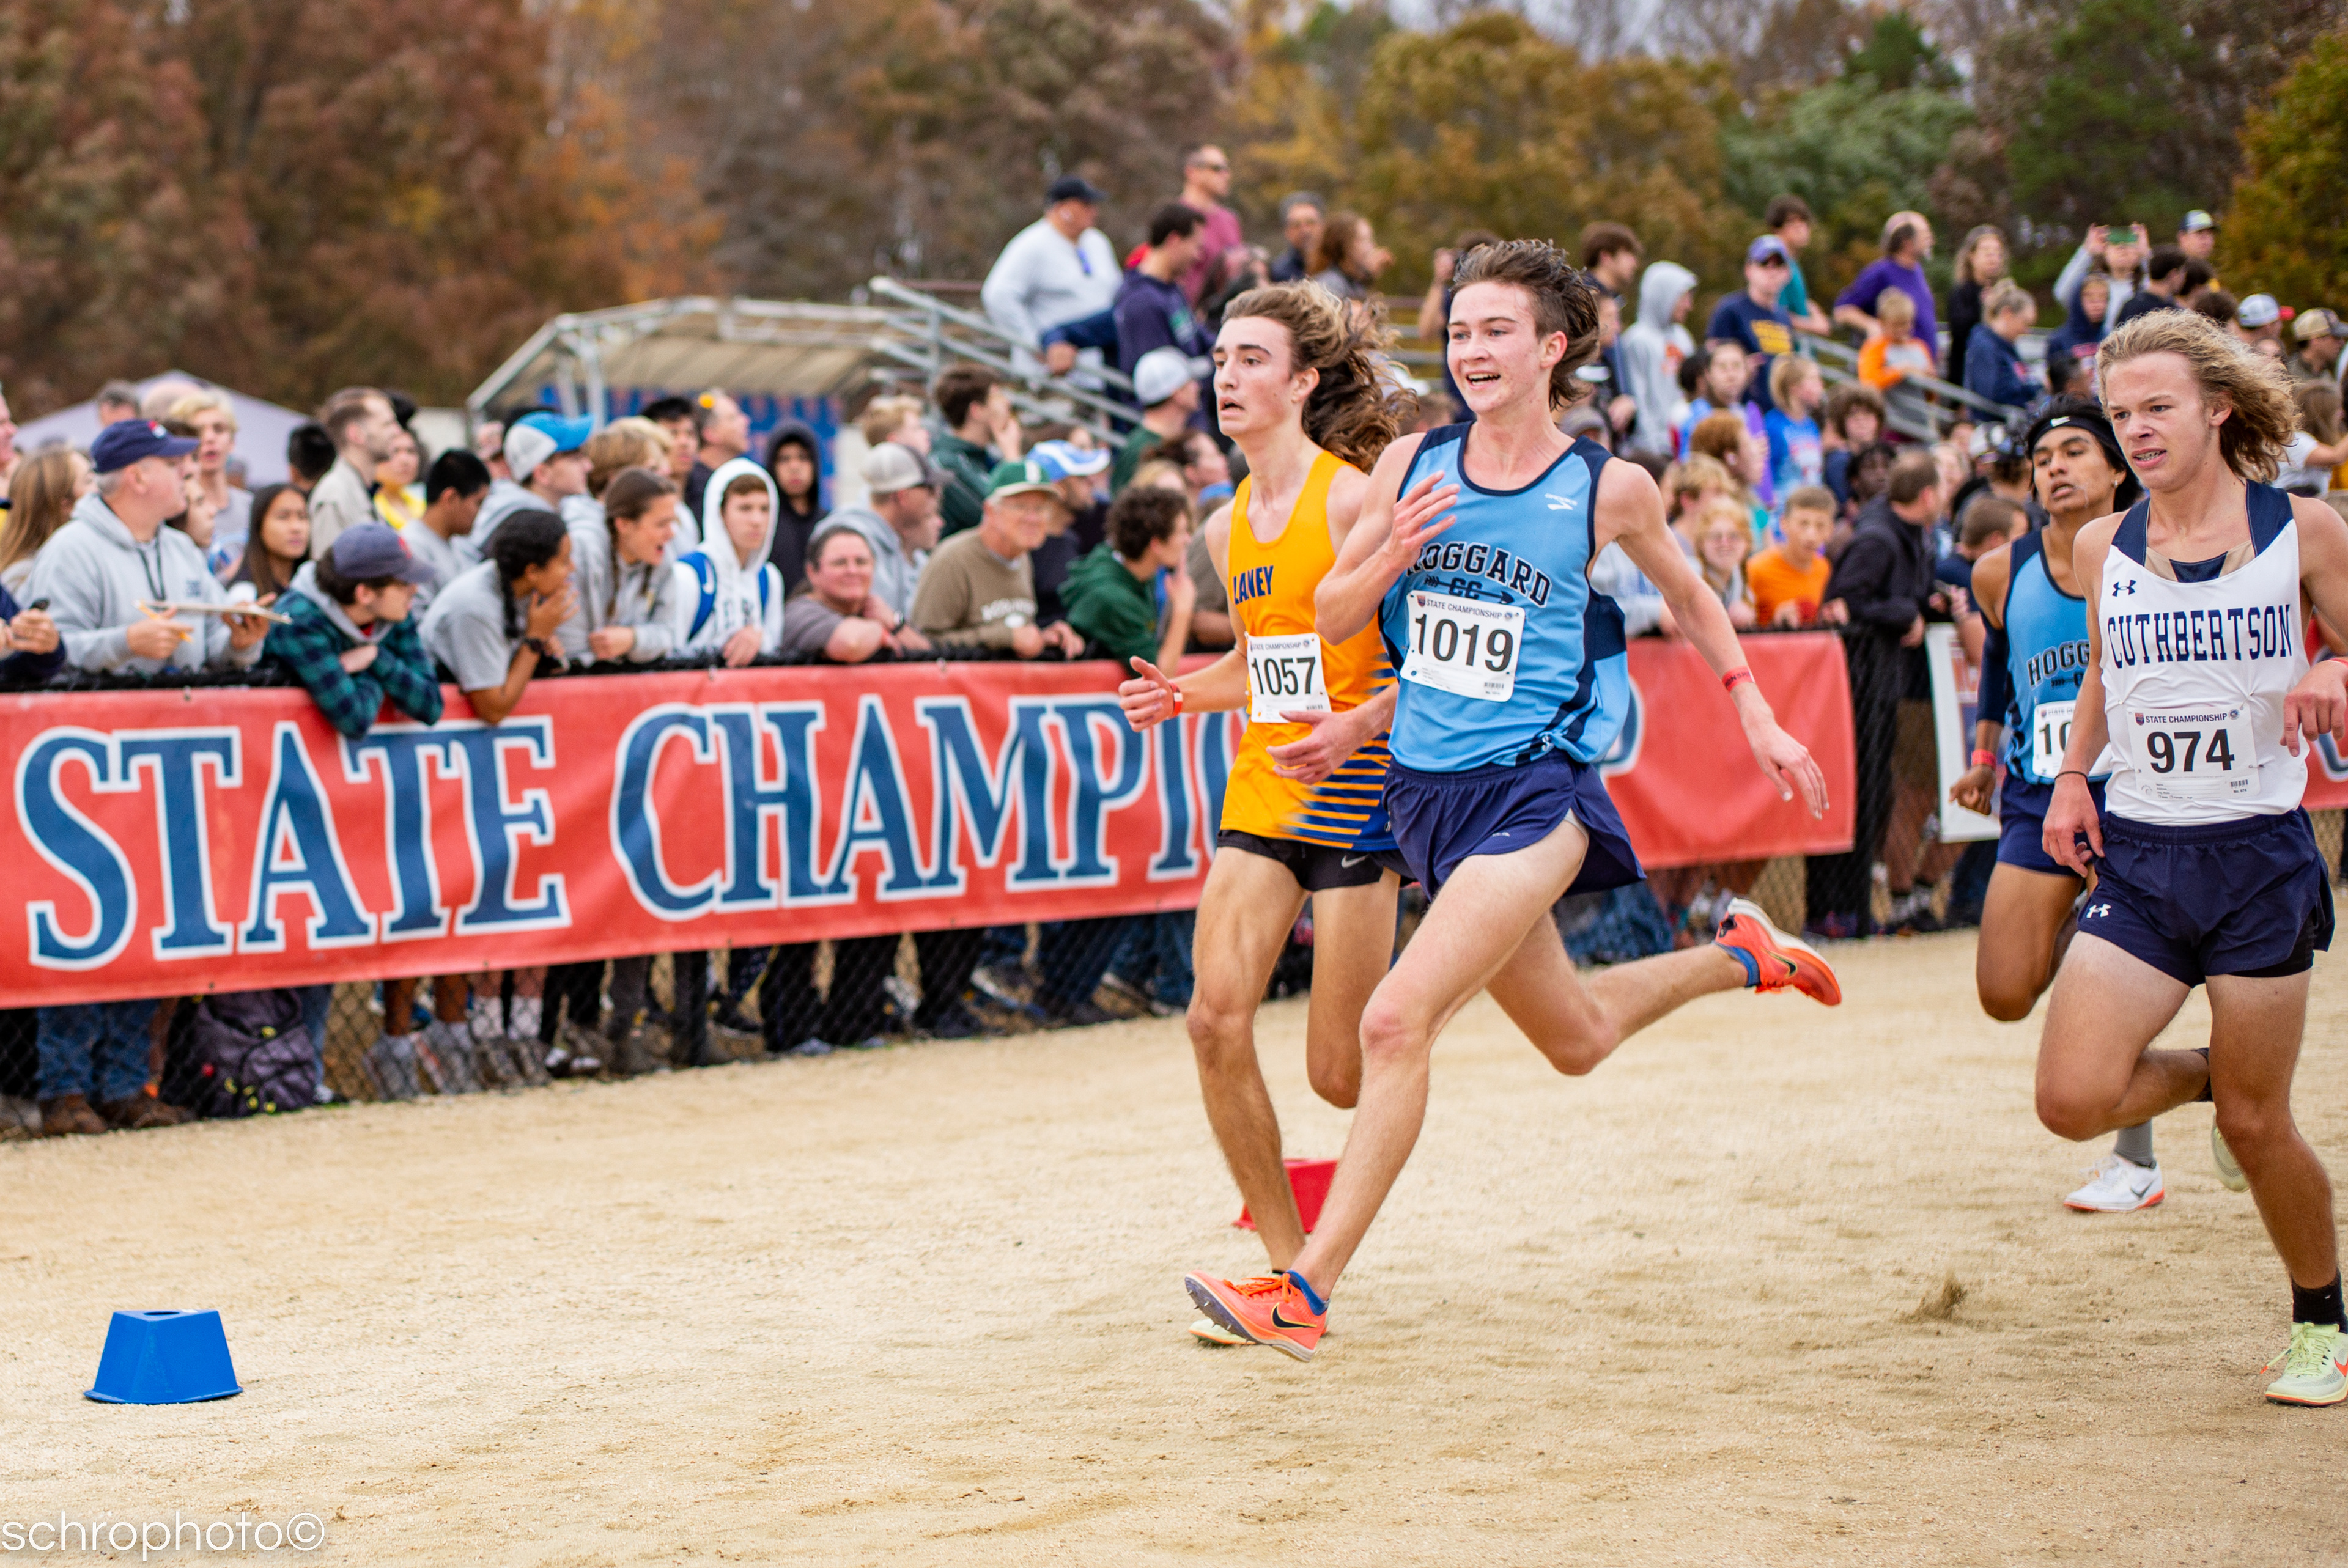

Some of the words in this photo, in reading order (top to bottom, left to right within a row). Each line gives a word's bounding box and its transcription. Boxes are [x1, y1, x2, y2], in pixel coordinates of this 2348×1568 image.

[1233, 565, 1274, 605] LANEY
[1448, 577, 1482, 600] CC
[1426, 599, 1445, 609] STATE
[1447, 603, 1502, 619] CHAMPIONSHIP
[1265, 642, 1302, 650] CHAMPIONSHIP
[1415, 613, 1513, 672] 1019
[2108, 604, 2292, 669] CUTHBERTSON
[1251, 657, 1316, 696] 1057
[2169, 713, 2228, 723] CHAMPIONSHIP
[2147, 728, 2235, 773] 974
[14, 716, 572, 972] STATE
